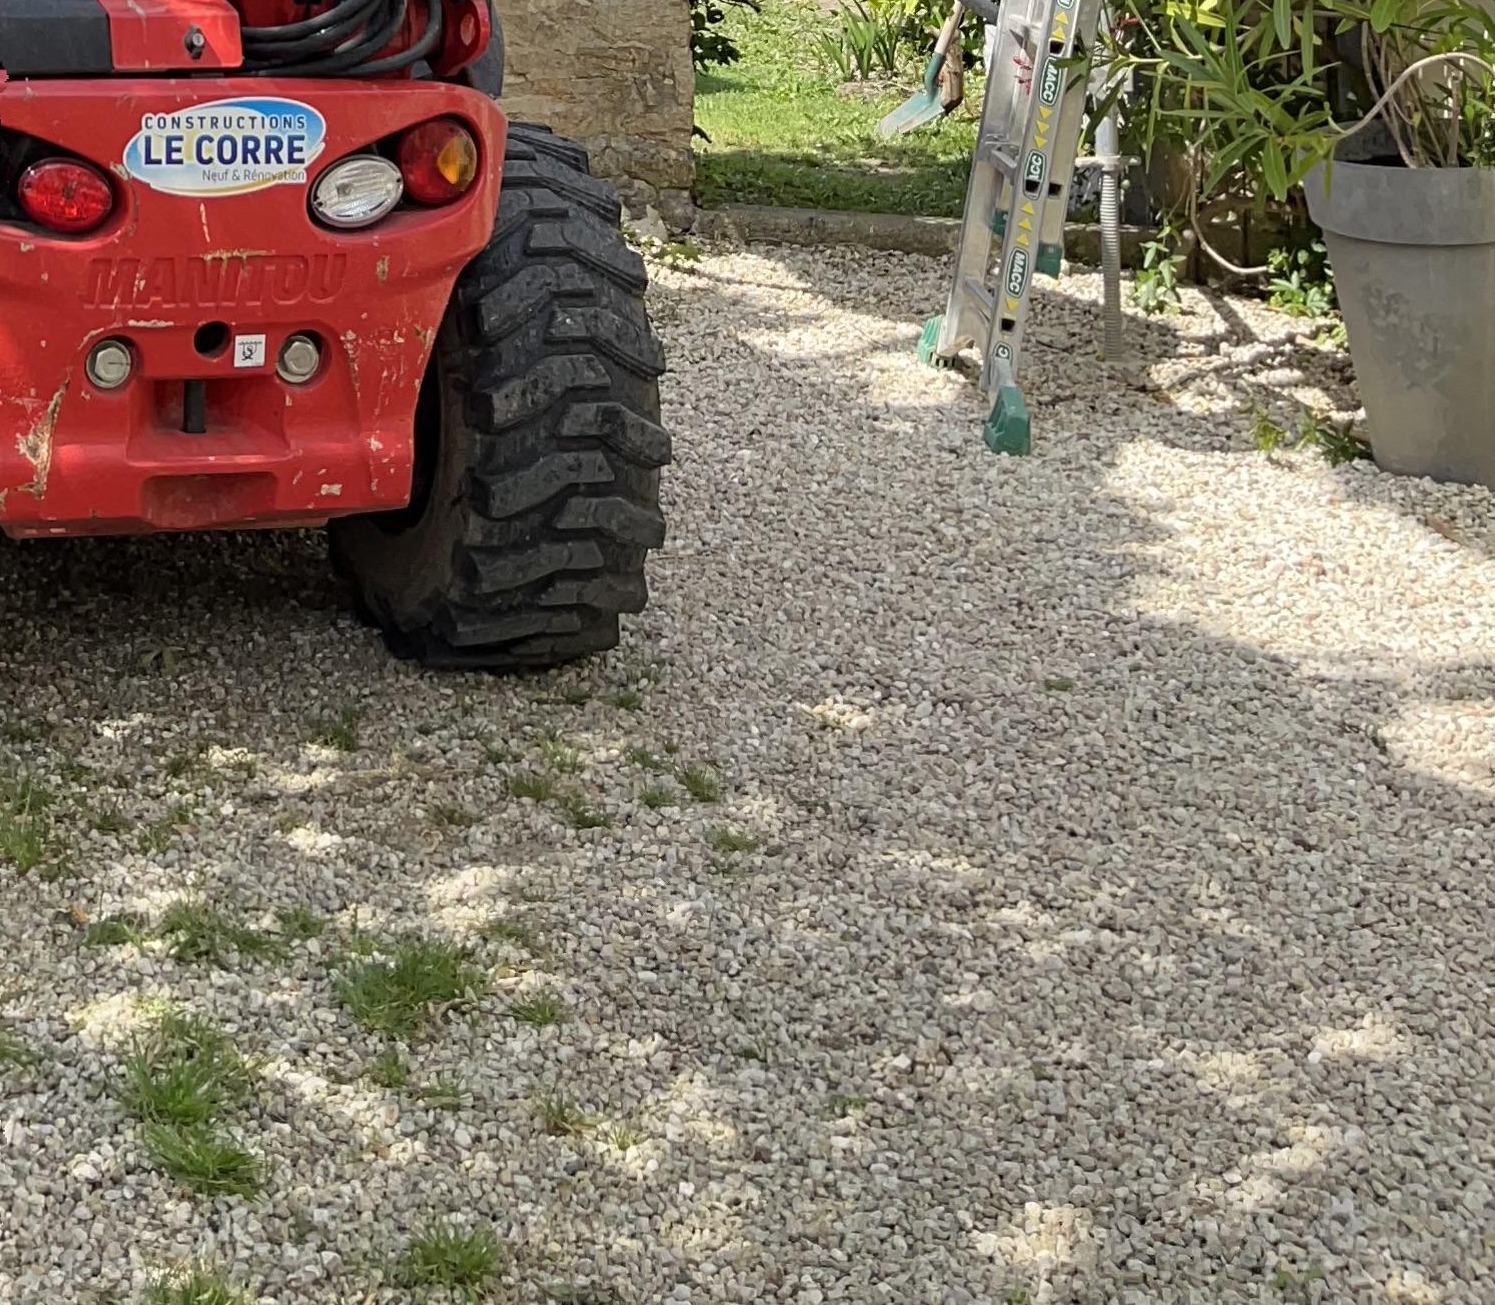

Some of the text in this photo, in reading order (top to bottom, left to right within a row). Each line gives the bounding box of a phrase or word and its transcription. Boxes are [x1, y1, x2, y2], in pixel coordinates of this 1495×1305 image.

[144, 116, 306, 130] CONSTRUCTIONS
[144, 135, 306, 166] LE CORRE
[202, 168, 306, 183] Neuf & Rénovation
[1009, 251, 1026, 295] MACC
